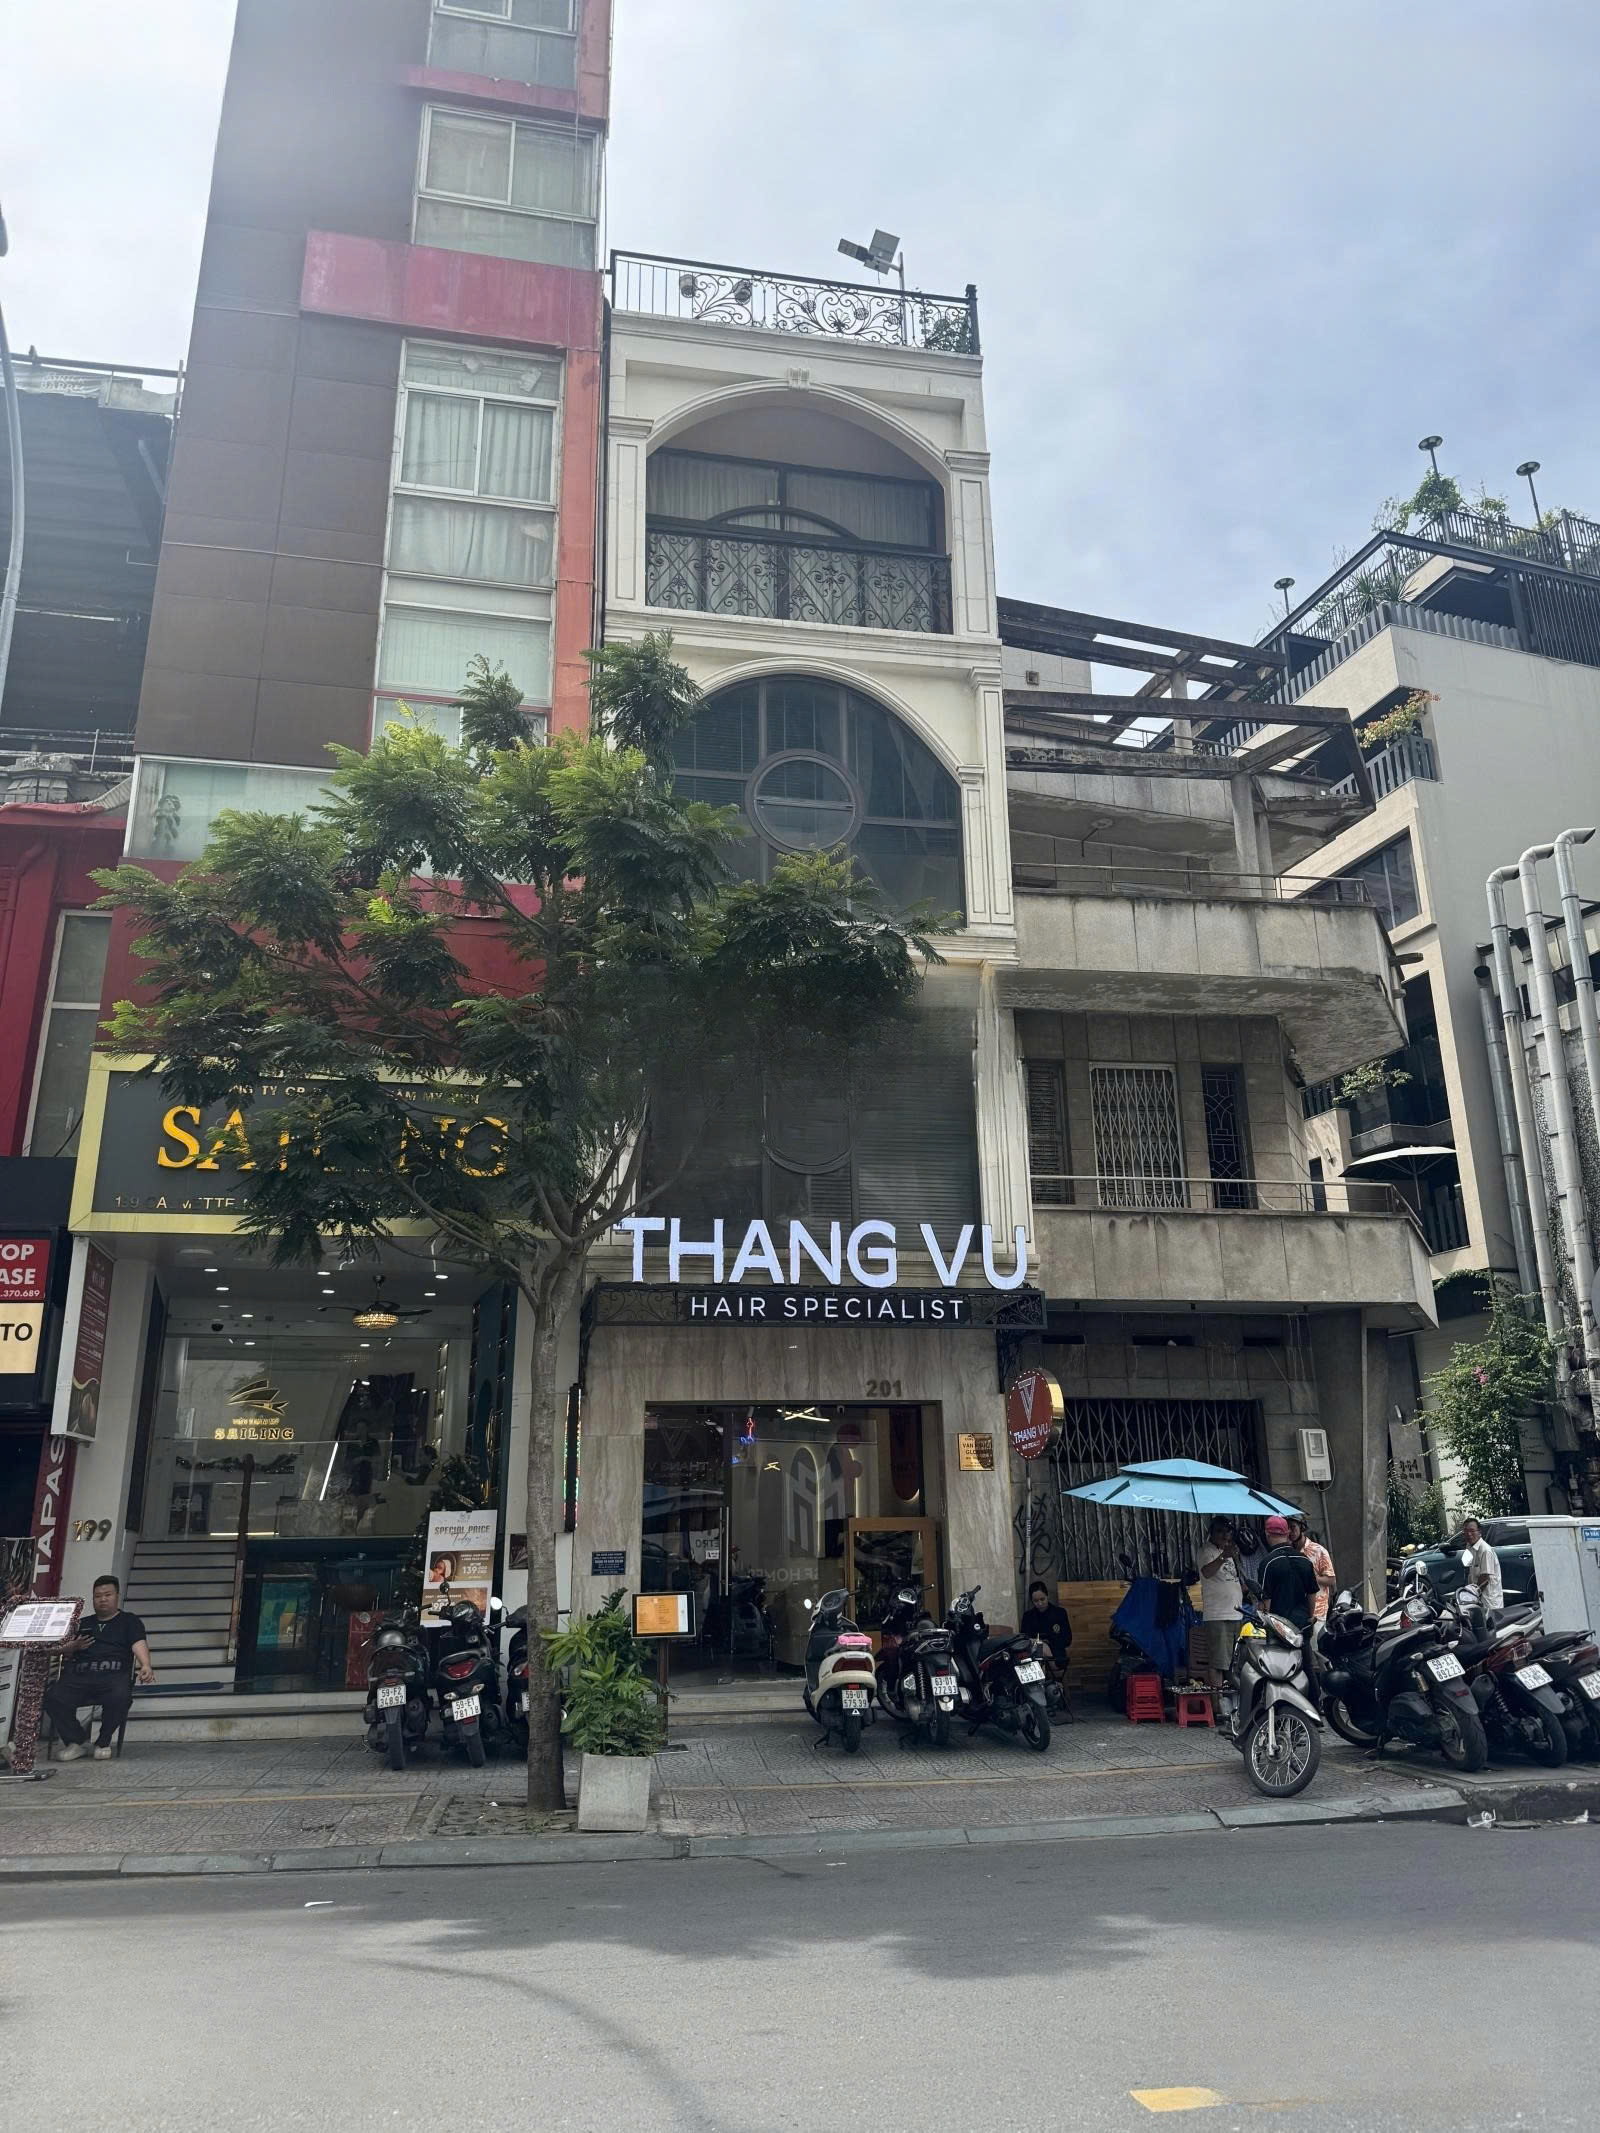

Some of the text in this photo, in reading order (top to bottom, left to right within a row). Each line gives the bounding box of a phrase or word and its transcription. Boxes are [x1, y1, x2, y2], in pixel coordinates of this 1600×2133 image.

[614, 1217, 1028, 1290] THANG VU
[691, 1297, 964, 1320] HAIR SPECIALIST
[865, 1379, 902, 1398] 201
[214, 1428, 294, 1440] SAILING
[1013, 1423, 1049, 1444] THANG VU
[32, 1436, 66, 1583] TAPAS
[73, 1518, 113, 1542] 199
[434, 1525, 491, 1535] SPECIAL PRICE
